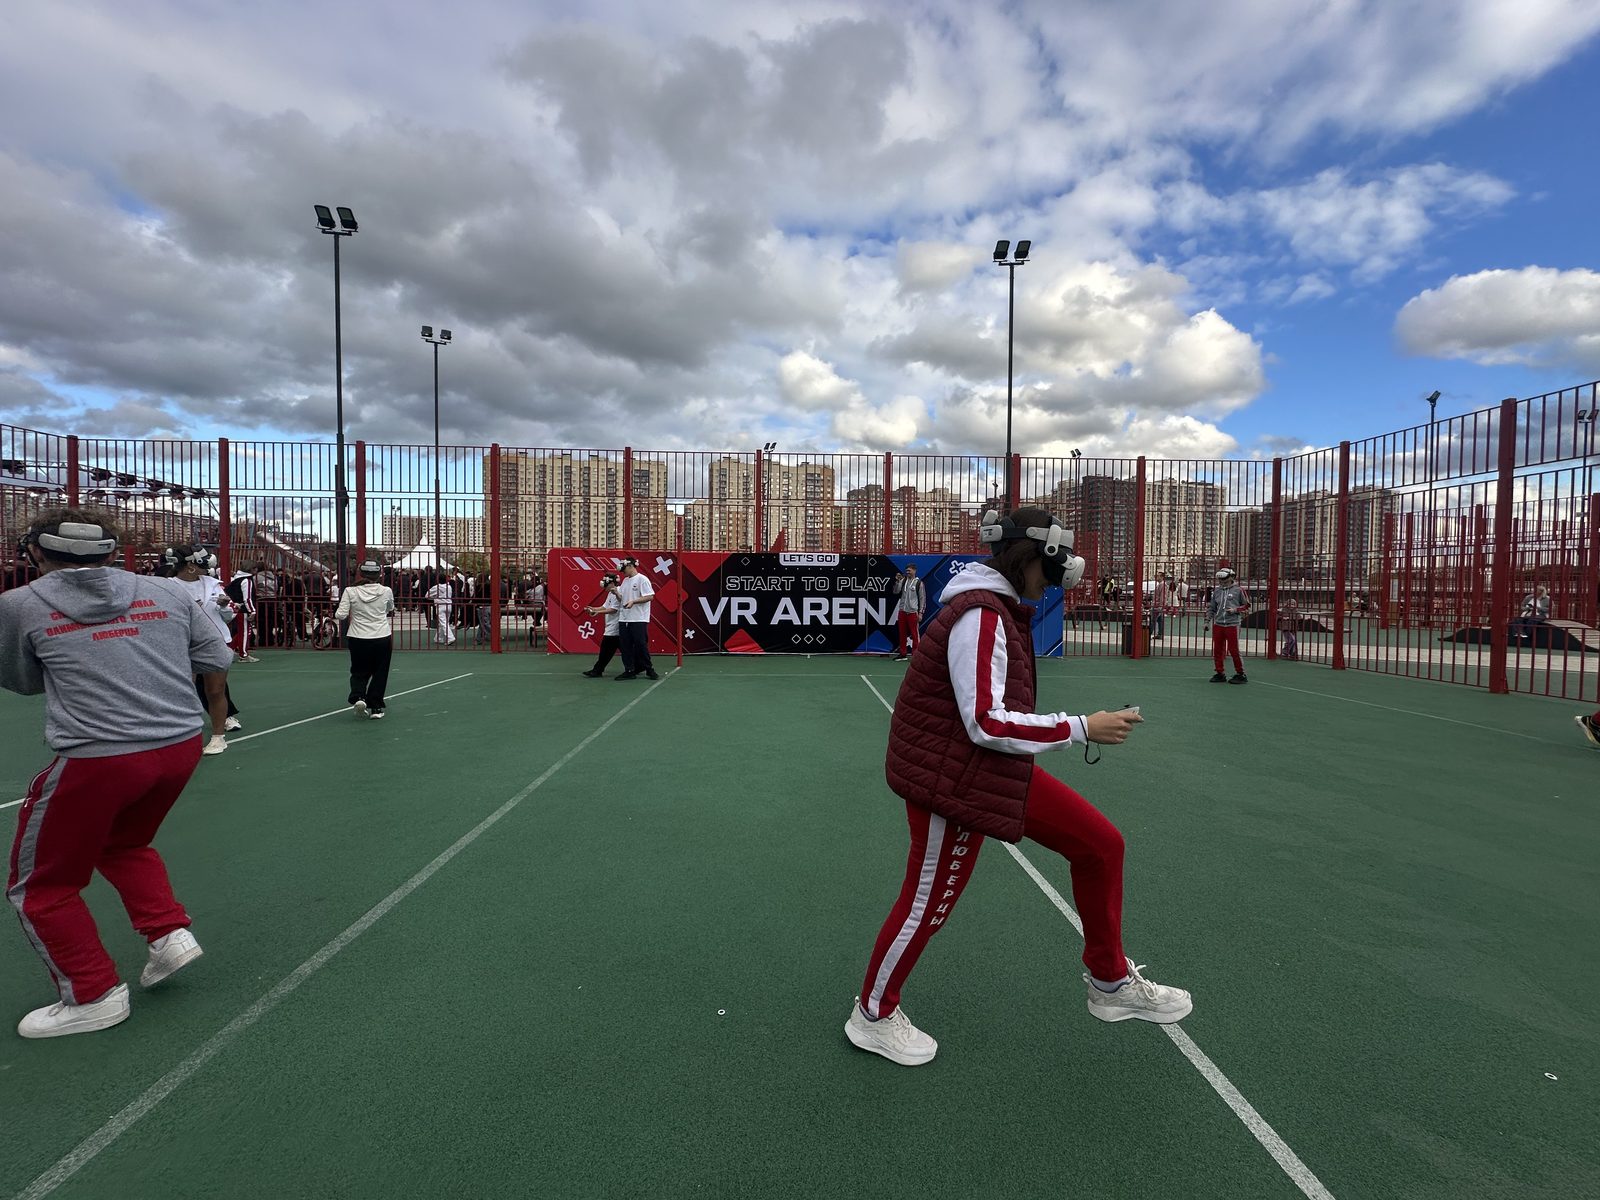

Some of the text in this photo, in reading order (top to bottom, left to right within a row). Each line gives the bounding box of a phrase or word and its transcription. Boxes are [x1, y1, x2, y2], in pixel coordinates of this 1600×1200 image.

[783, 554, 836, 563] LET'S GO!
[726, 576, 890, 592] START TO PLAY
[698, 596, 758, 625] VR
[929, 831, 971, 927] ЛЮБЕРЦЫ
